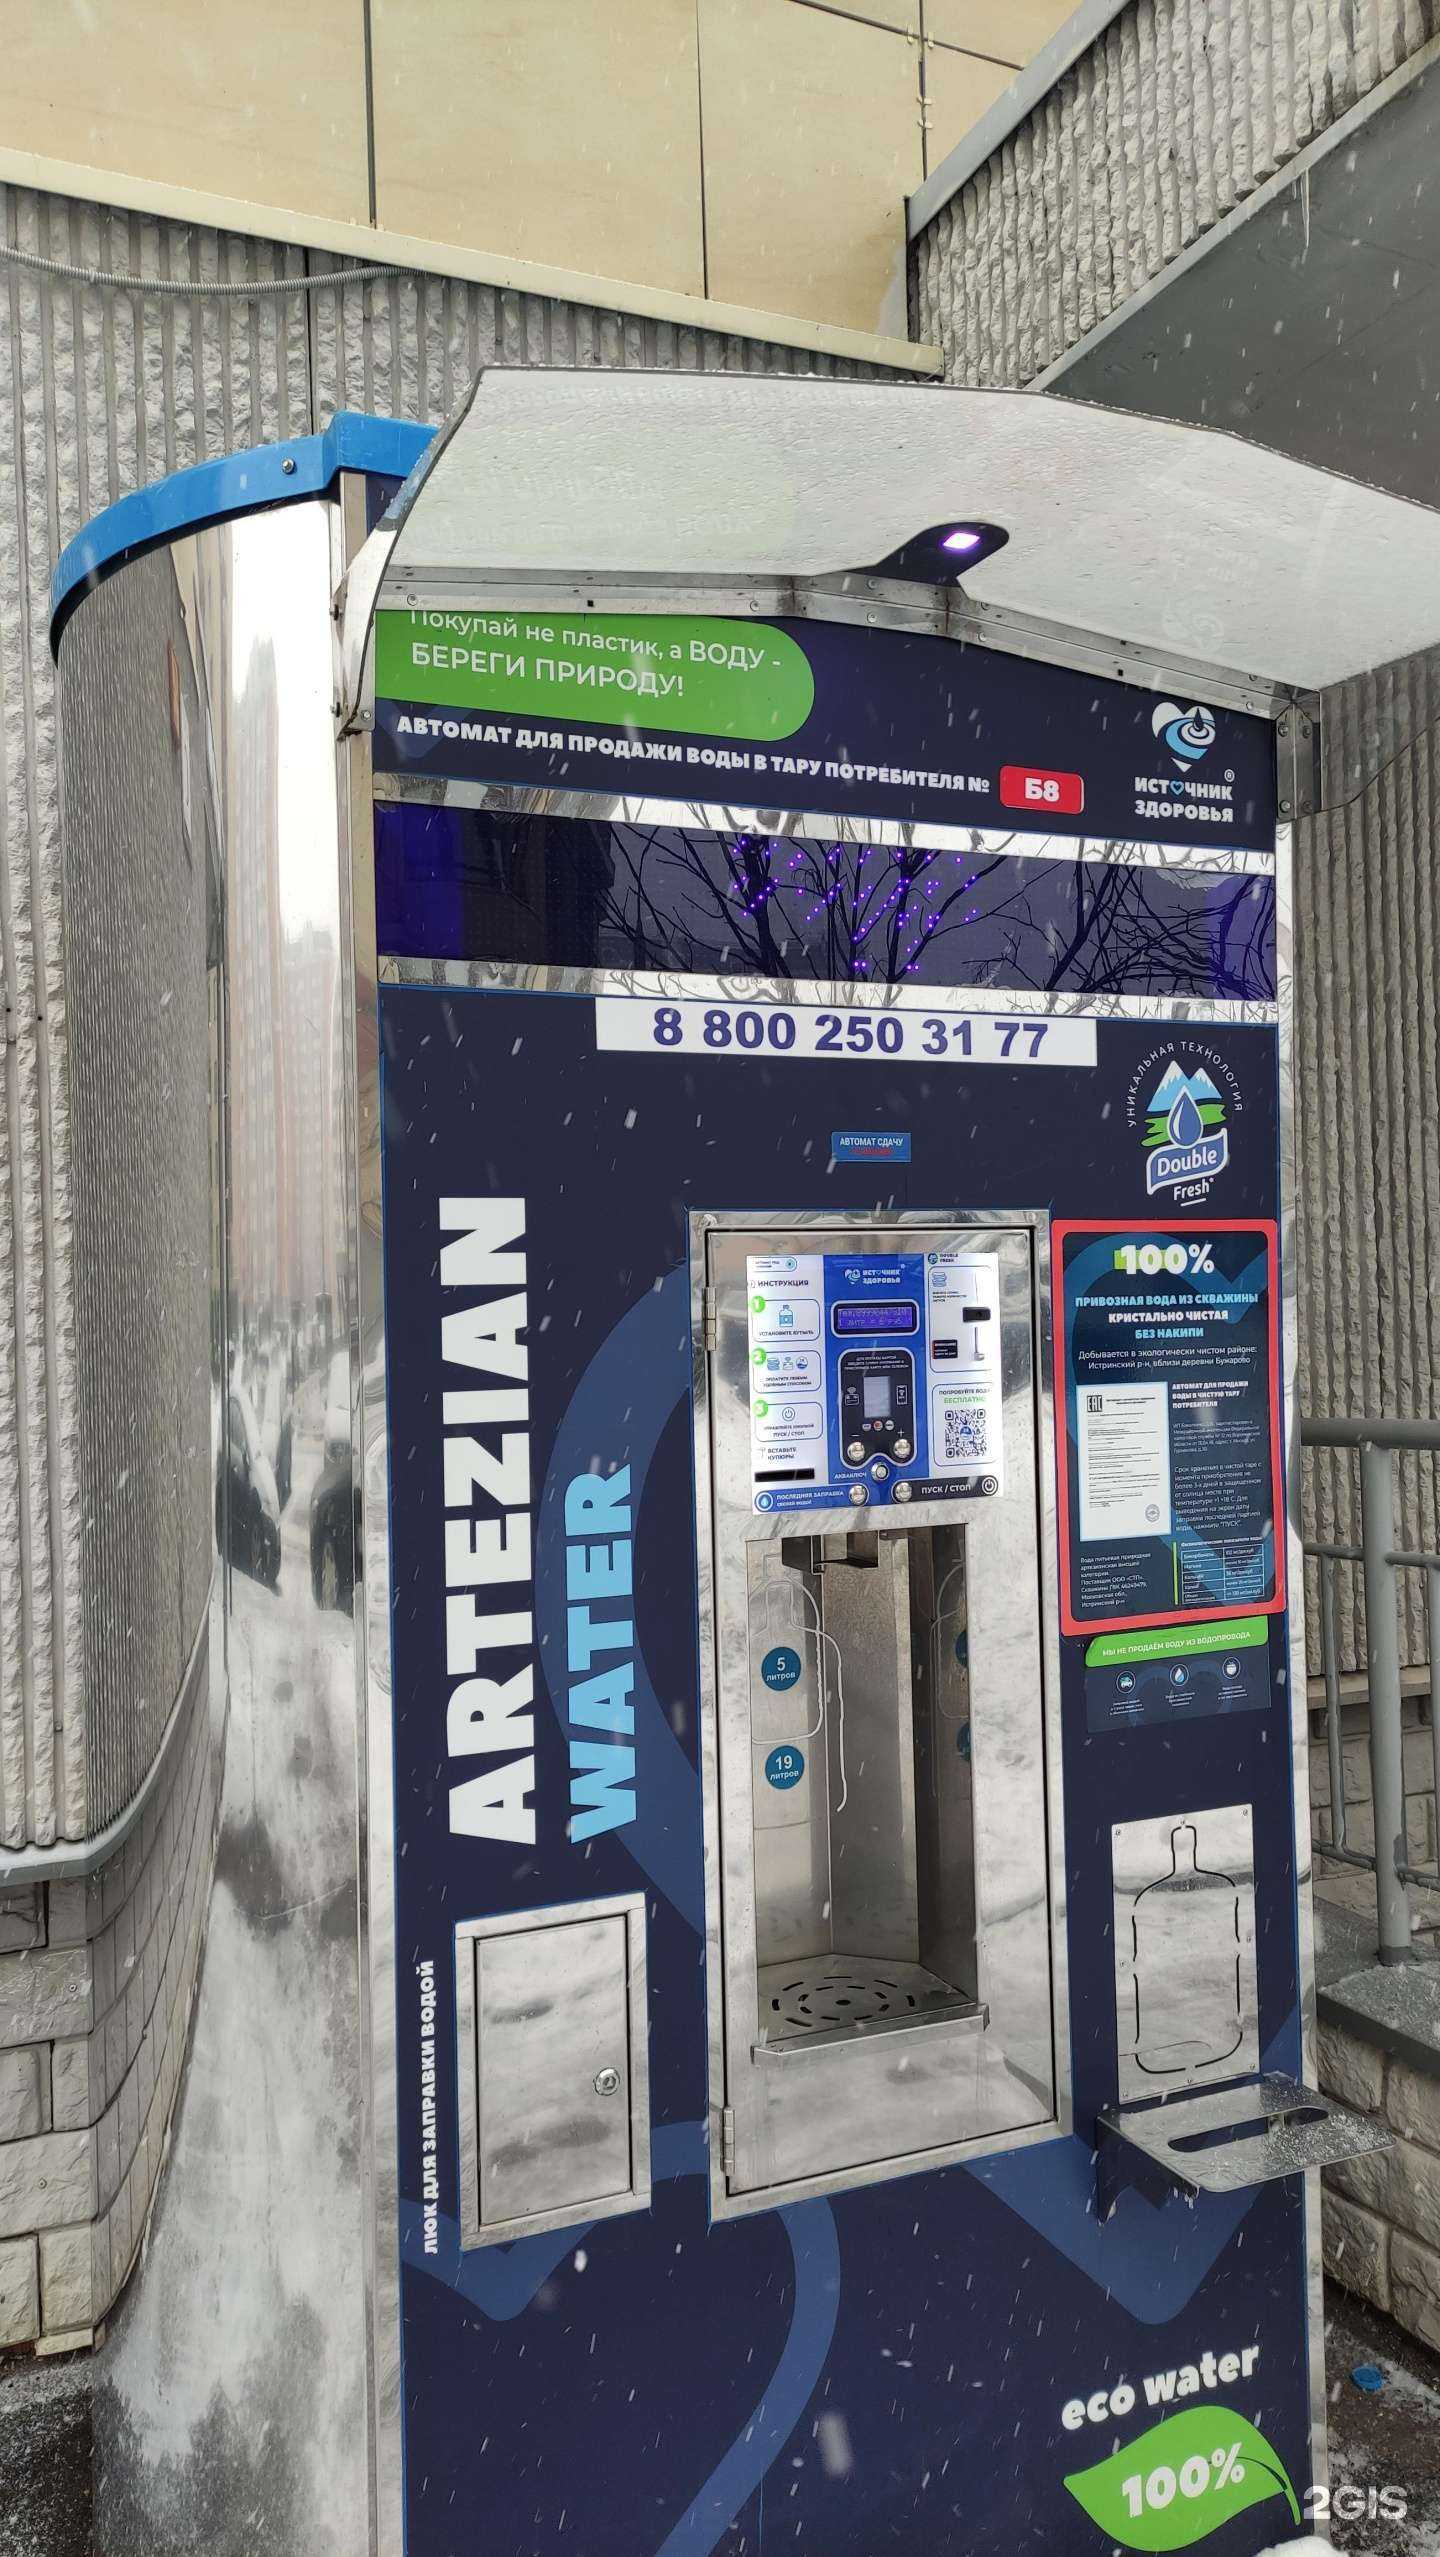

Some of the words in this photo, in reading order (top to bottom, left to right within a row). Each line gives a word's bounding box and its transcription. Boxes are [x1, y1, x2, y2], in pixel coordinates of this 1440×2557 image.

[526, 626, 554, 642] не
[562, 629, 663, 661] пластик,
[669, 643, 682, 659] а
[689, 640, 765, 669] ВОДУ
[411, 642, 526, 678] БЕРЕГИ
[535, 658, 684, 697] ПРИРОДУ!
[397, 716, 512, 744] АВТОМАТ
[515, 729, 563, 750] ДЛЯ
[568, 735, 683, 762] ПРОДАЖИ
[686, 746, 750, 770] ВОДЫ
[754, 754, 767, 770] В
[770, 756, 822, 776] ТАРУ
[825, 762, 965, 791] ПОТРЕБИТЕЛЯ
[967, 777, 990, 793] №
[1024, 777, 1060, 803] Б8
[1134, 799, 1234, 823] ЗДОРОВЬЯ
[653, 1007, 683, 1046] 8
[702, 1009, 796, 1050] 800
[815, 1014, 904, 1054] 250
[921, 1018, 973, 1056] 31
[993, 1022, 1049, 1058] 77
[1126, 1042, 1175, 1128] УНИКАЛЬНАЯ
[1180, 1041, 1243, 1111] ТЕХНОЛОГИЯ
[839, 1137, 876, 1146] АВТОМАТ
[877, 1137, 904, 1147] СДАЧУ
[1157, 1146, 1218, 1177] Double
[1119, 1243, 1216, 1275] 100%
[757, 1280, 809, 1289] ИНСТРУКЦИЯ
[1075, 1297, 1144, 1308] ПРИВОЗНАЯ
[1146, 1296, 1176, 1307] ВОДА
[1178, 1294, 1193, 1305] ИЗ
[1194, 1293, 1259, 1304] СКВАЖИНЫ
[1108, 1311, 1184, 1324] КРИСТАЛЬНО
[1186, 1310, 1229, 1322] ЧИСТАЯ
[1134, 1328, 1156, 1340] БЕЗ
[1157, 1327, 1204, 1339] НАКИПИ
[1078, 1350, 1129, 1361] Добывается
[1137, 1348, 1196, 1359] экологически
[1196, 1346, 1226, 1356] чистом
[1088, 1360, 1136, 1372] Истринский
[1152, 1358, 1181, 1368] вблизи
[1181, 1357, 1214, 1368] деревни
[1172, 1382, 1203, 1391] АВТОМАТ
[1203, 1382, 1217, 1391] ДЛЯ
[1217, 1380, 1249, 1389] ПРОДАЖИ
[1172, 1392, 1192, 1400] ВОДЫ
[1197, 1391, 1225, 1399] ЧИСТУЮ
[1225, 1390, 1240, 1398] ТАРУ
[1172, 1400, 1218, 1409] ПОТРЕБИТЕЛЯ
[921, 1486, 944, 1495] ПУСК
[949, 1484, 972, 1493] СТОП
[438, 1197, 537, 1845] ARTEZIAN
[564, 1463, 637, 1845] WATER
[1102, 1649, 1116, 1657] МЫ
[1116, 1647, 1127, 1655] НЕ
[1165, 1640, 1185, 1650] ВОДУ
[1186, 1638, 1196, 1647] ИЗ
[1197, 1631, 1251, 1646] ВОДОПРОВОДА
[766, 1671, 796, 1681] литров
[777, 1656, 786, 1671] 5
[770, 1770, 799, 1780] литров
[775, 1755, 793, 1770] 19
[416, 1960, 437, 2038] ВОДОЙ
[421, 2039, 438, 2152] ЗАПРАВКИ
[423, 2155, 439, 2200] ДЛЯ
[423, 2202, 438, 2254] ЛЮК
[1061, 2384, 1136, 2431] eco
[1142, 2345, 1260, 2407] water
[1121, 2442, 1246, 2519] 100%
